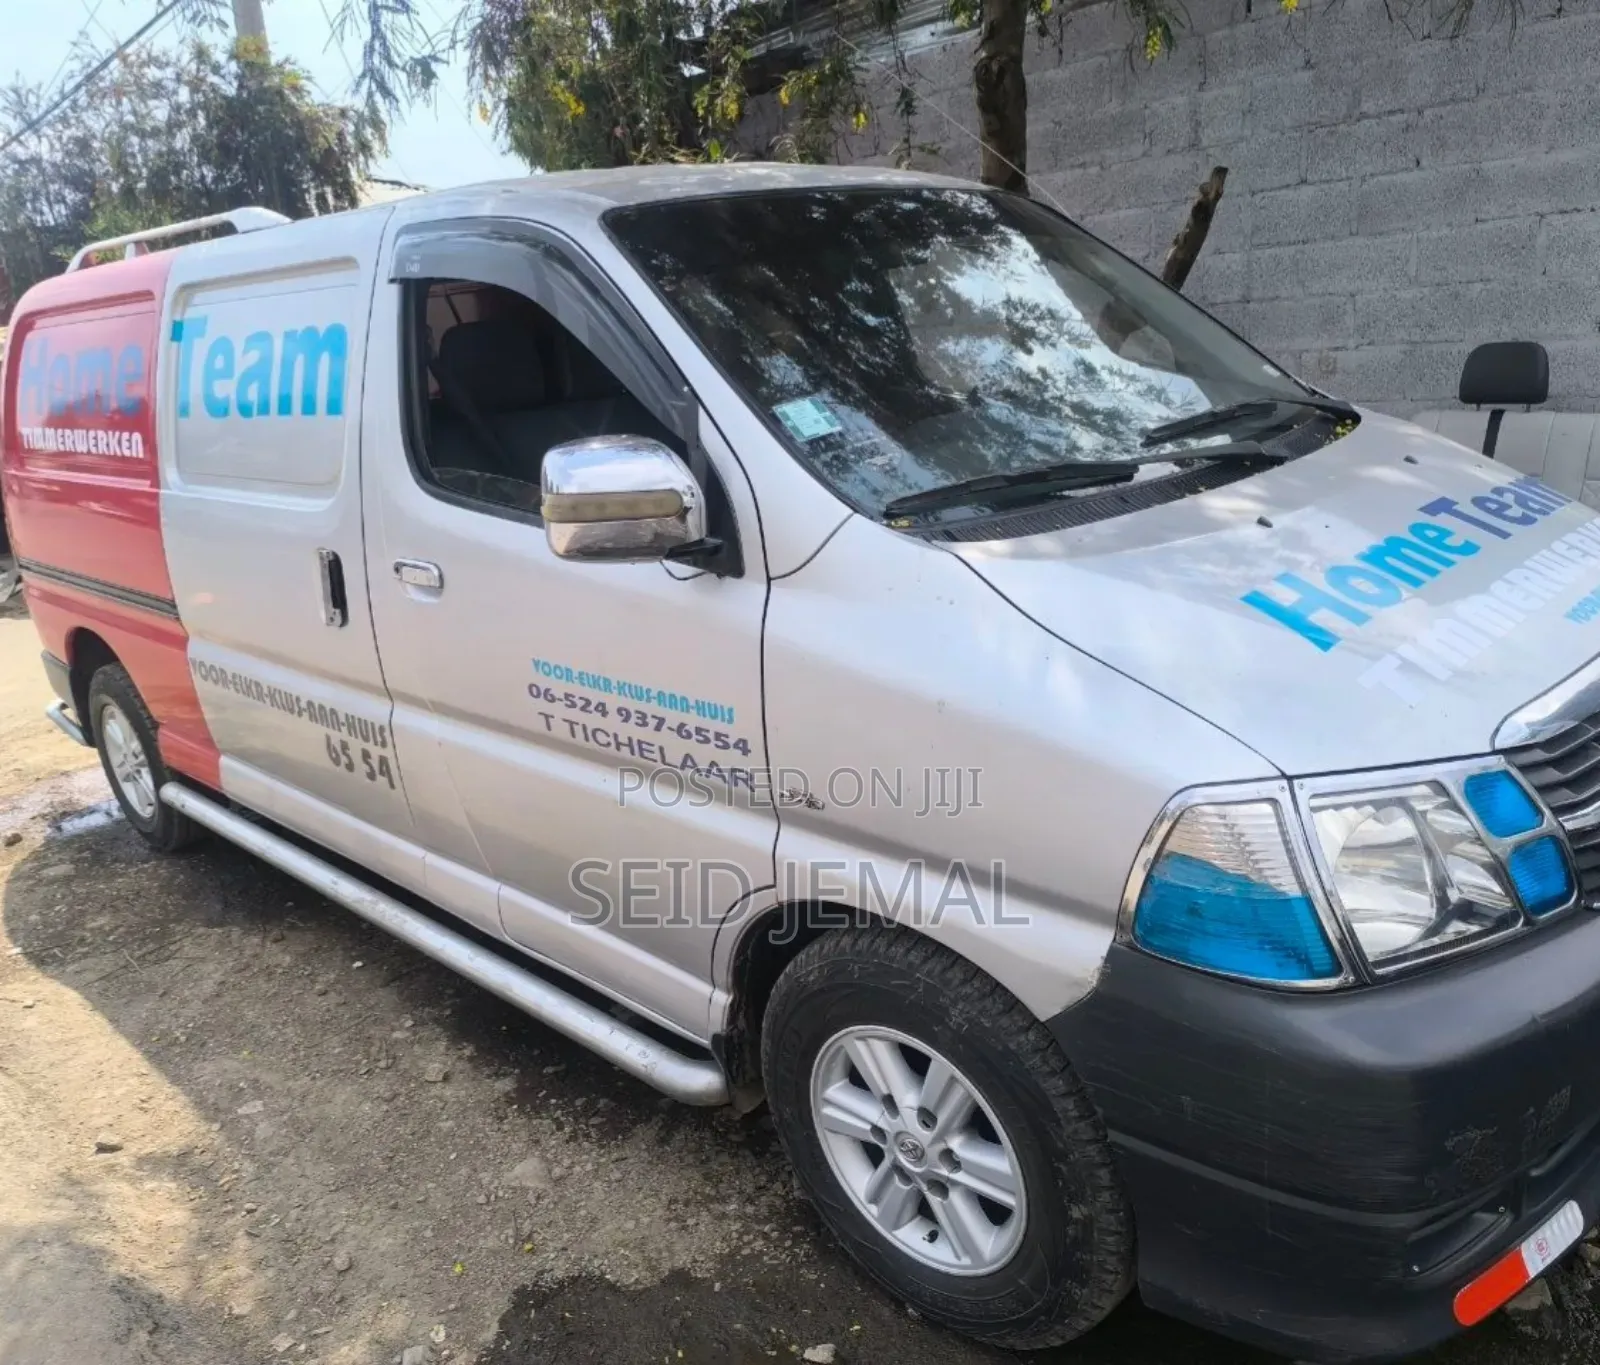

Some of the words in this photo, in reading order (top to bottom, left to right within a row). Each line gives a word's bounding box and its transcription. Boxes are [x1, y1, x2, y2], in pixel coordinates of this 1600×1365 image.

[18, 335, 146, 418] Home
[172, 315, 348, 419] Team
[20, 427, 145, 458] TIMMERWERKEN
[528, 683, 609, 718] 06-524
[616, 706, 752, 757] 937-6554
[538, 711, 556, 732] T
[562, 718, 756, 792] TICHELAAR
